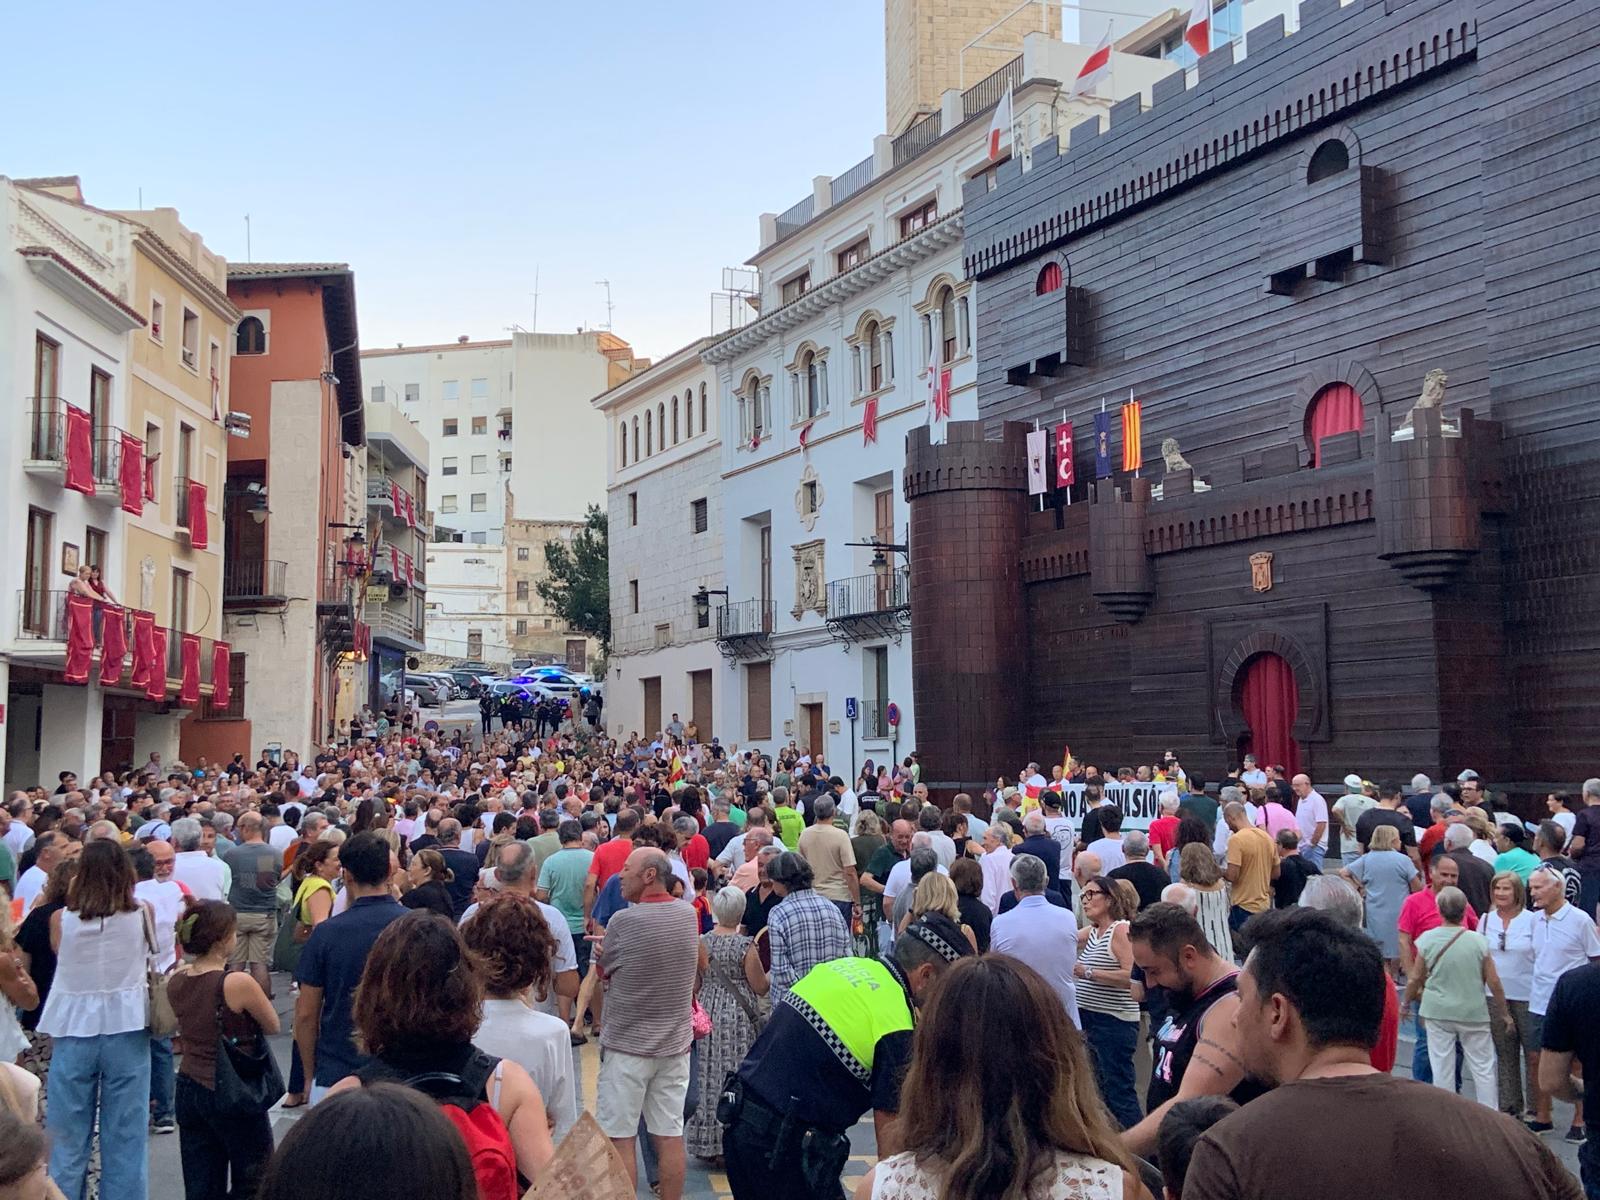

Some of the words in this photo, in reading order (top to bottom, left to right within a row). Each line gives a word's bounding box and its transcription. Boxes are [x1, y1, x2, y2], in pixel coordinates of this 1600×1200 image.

[1060, 790, 1077, 818] NO
[1079, 790, 1088, 818] A
[1104, 784, 1162, 819] NVASIÓ
[844, 958, 881, 991] OLICIA
